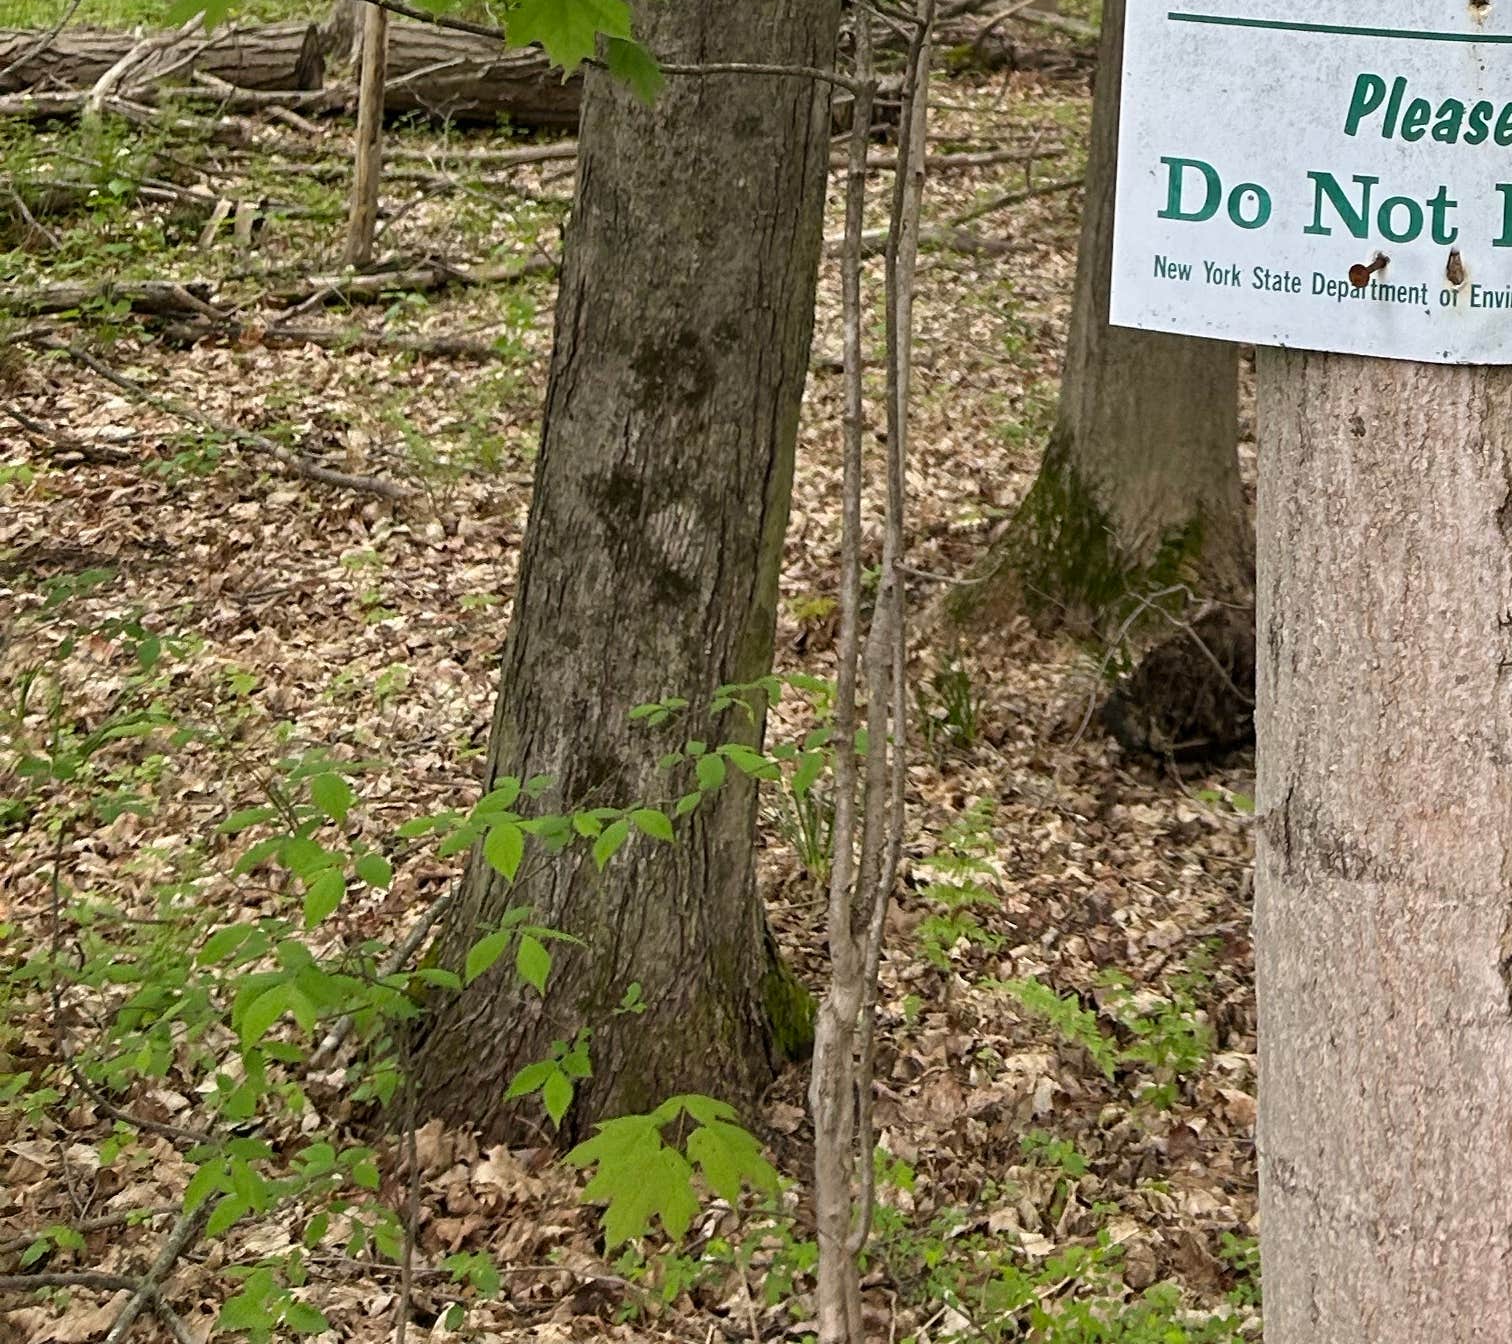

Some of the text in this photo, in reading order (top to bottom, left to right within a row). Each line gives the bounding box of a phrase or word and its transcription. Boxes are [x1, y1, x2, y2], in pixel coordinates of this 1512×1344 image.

[1156, 155, 1272, 230] Do
[1302, 170, 1460, 246] Not
[1153, 254, 1193, 282] New
[1202, 260, 1242, 288] York
[1251, 266, 1302, 294] State
